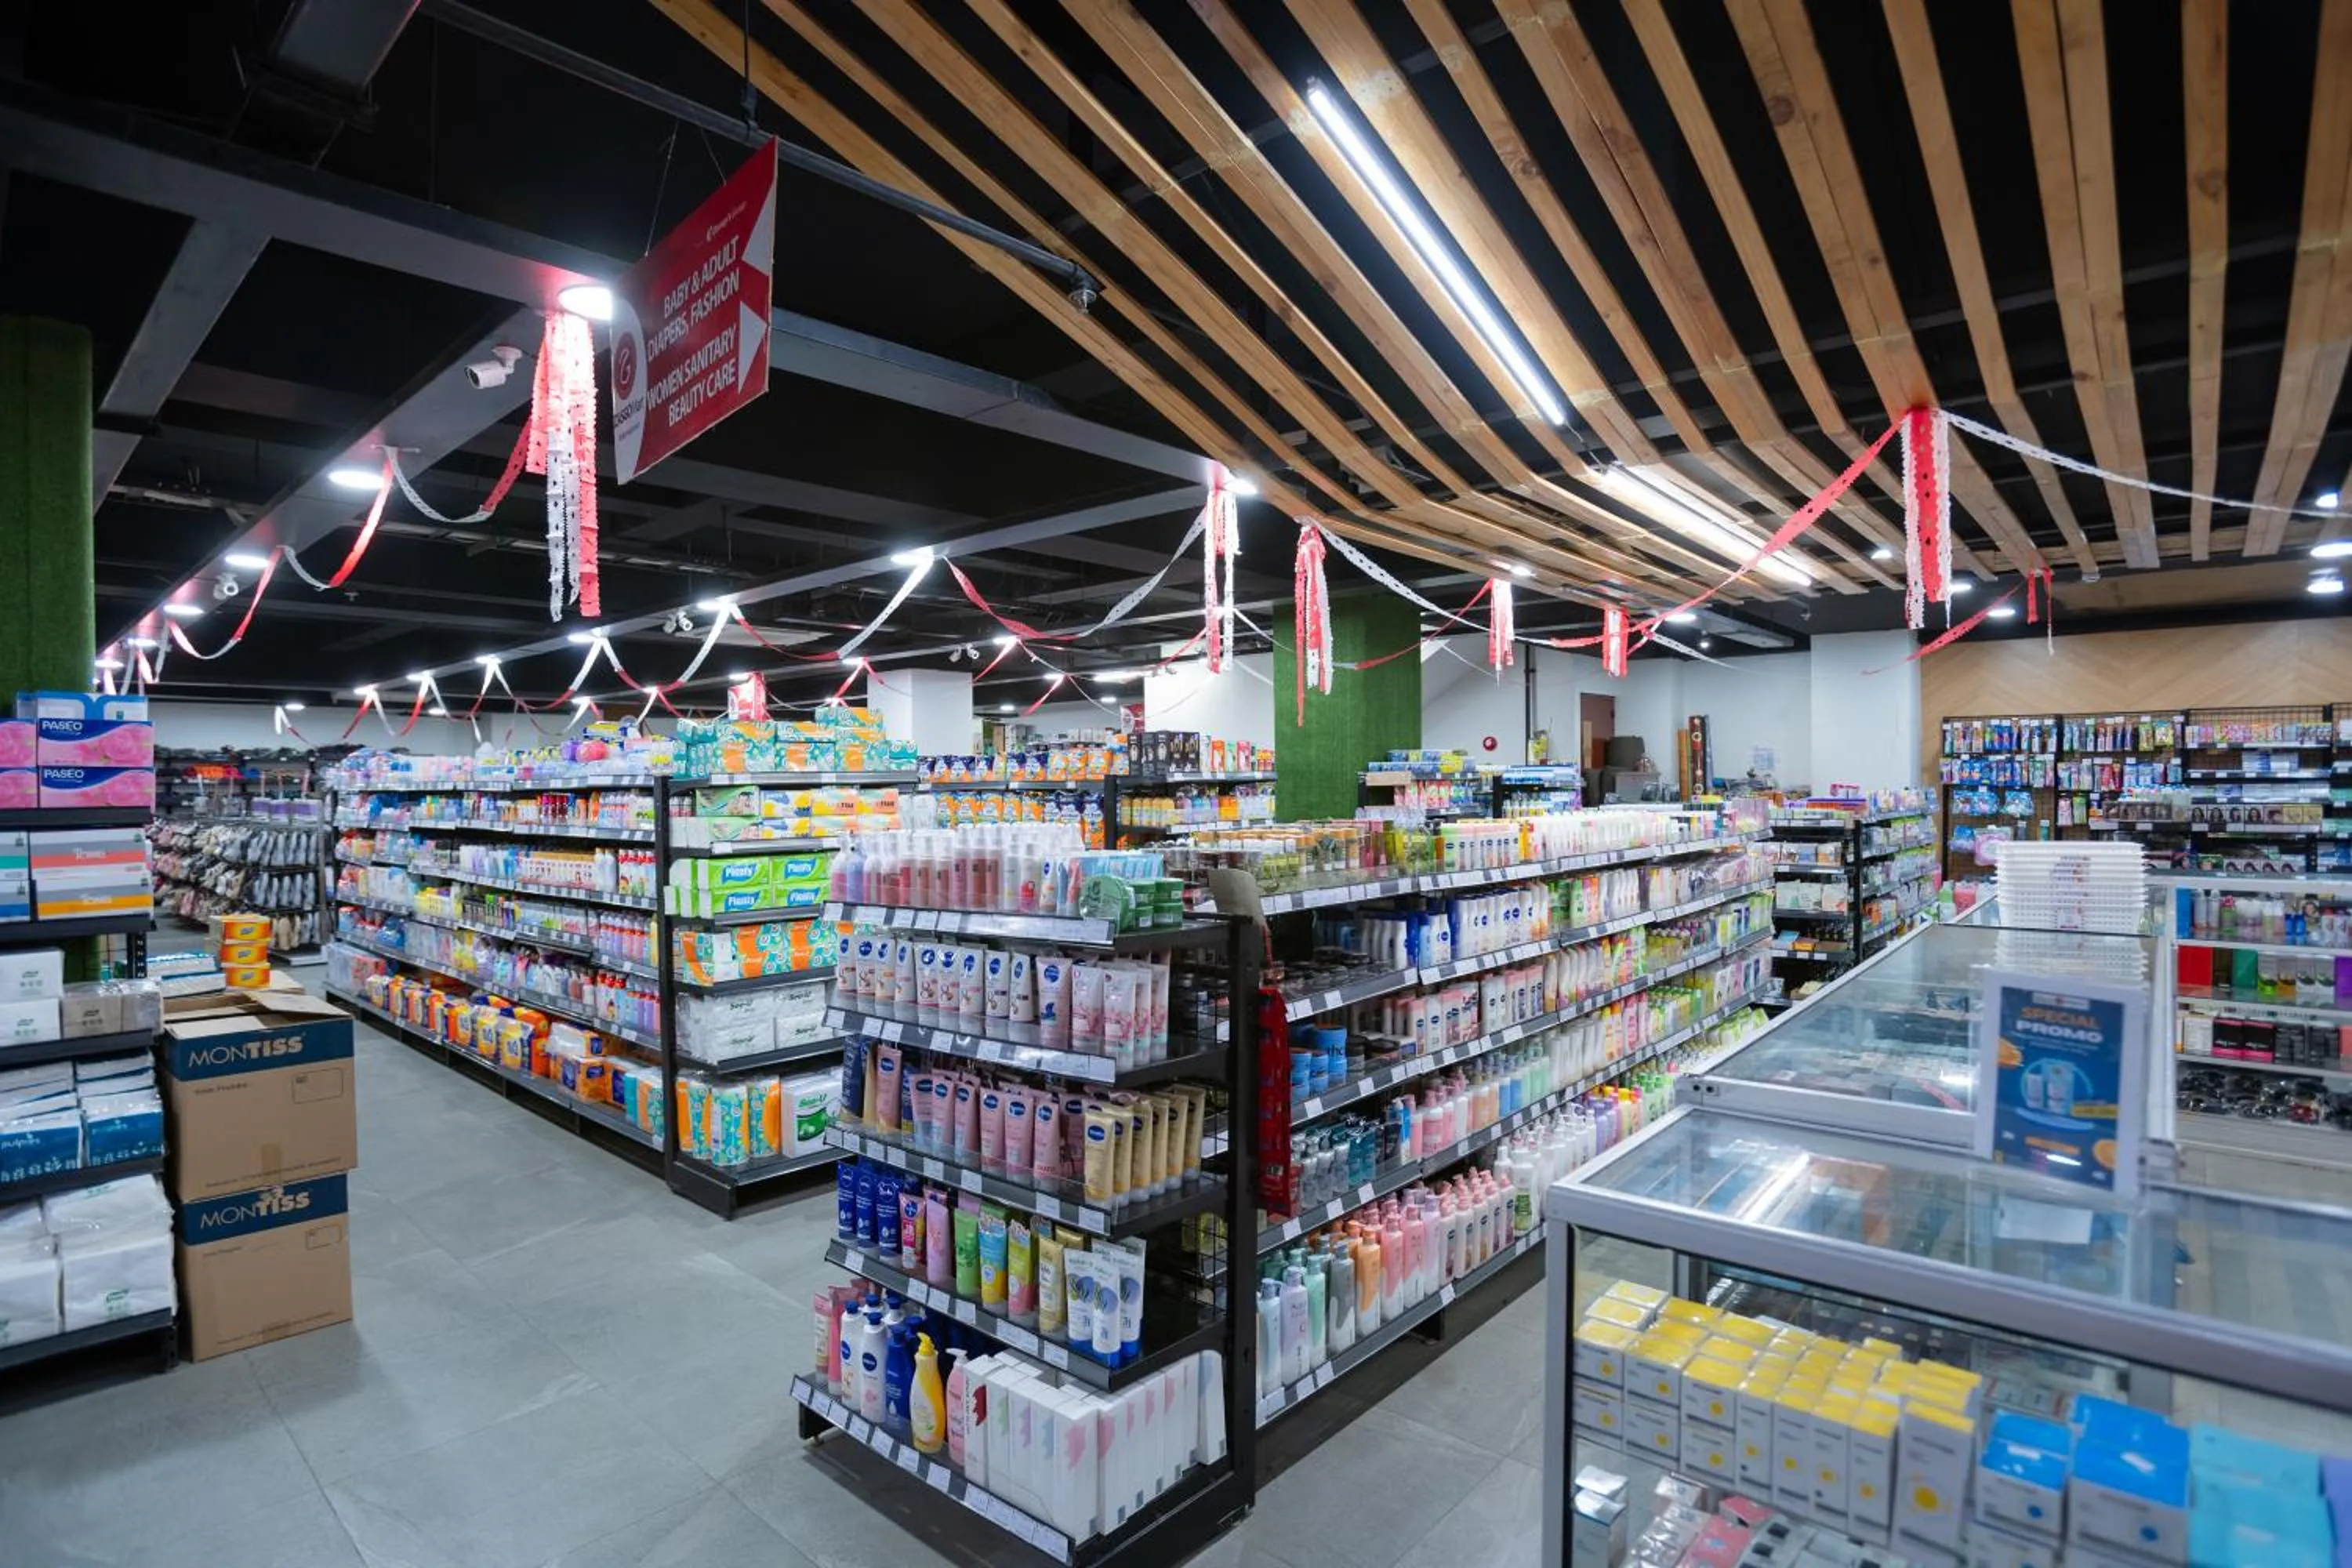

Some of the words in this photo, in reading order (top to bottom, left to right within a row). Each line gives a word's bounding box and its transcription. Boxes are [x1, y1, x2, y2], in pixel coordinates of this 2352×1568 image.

[664, 275, 691, 319] BABY
[691, 270, 700, 295] &
[701, 234, 739, 289] ADULT
[691, 267, 739, 327] FASHION
[647, 365, 684, 411] WOMEN
[684, 323, 736, 383] SANITARY
[668, 379, 706, 427] BEAUTY
[706, 358, 736, 398] CARE
[42, 720, 83, 731] PASEO
[44, 769, 85, 779] PASEO
[2016, 1019, 2103, 1044] PROMO
[188, 1036, 303, 1067] MONTISS
[200, 1192, 311, 1229] MONTISS
